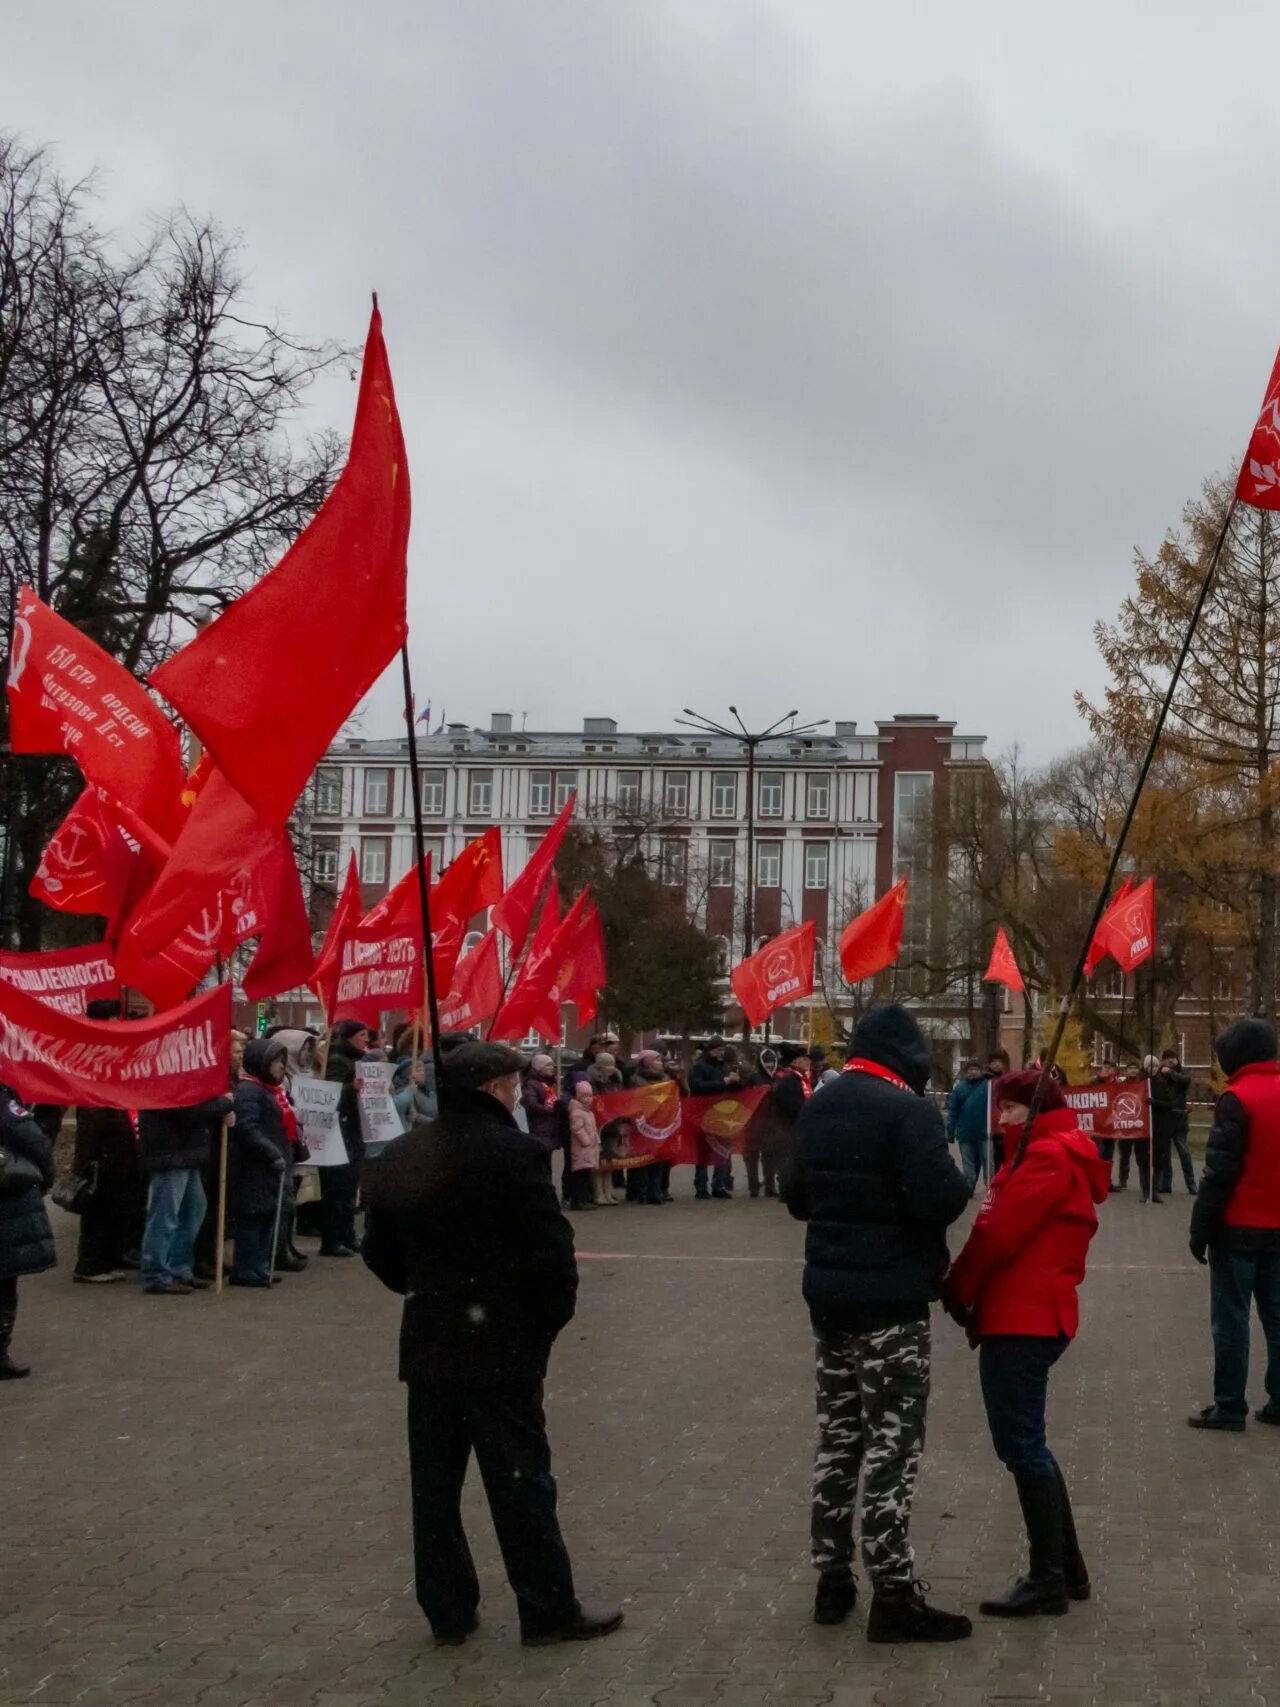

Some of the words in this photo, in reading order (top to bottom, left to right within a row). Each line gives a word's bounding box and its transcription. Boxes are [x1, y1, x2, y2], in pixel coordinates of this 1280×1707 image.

[46, 644, 76, 669] 150
[68, 664, 96, 689] СТР.
[101, 693, 150, 738] ОРДЕНА
[155, 1020, 218, 1076] ВОЙНА!
[1114, 1120, 1143, 1129] КПРФ
